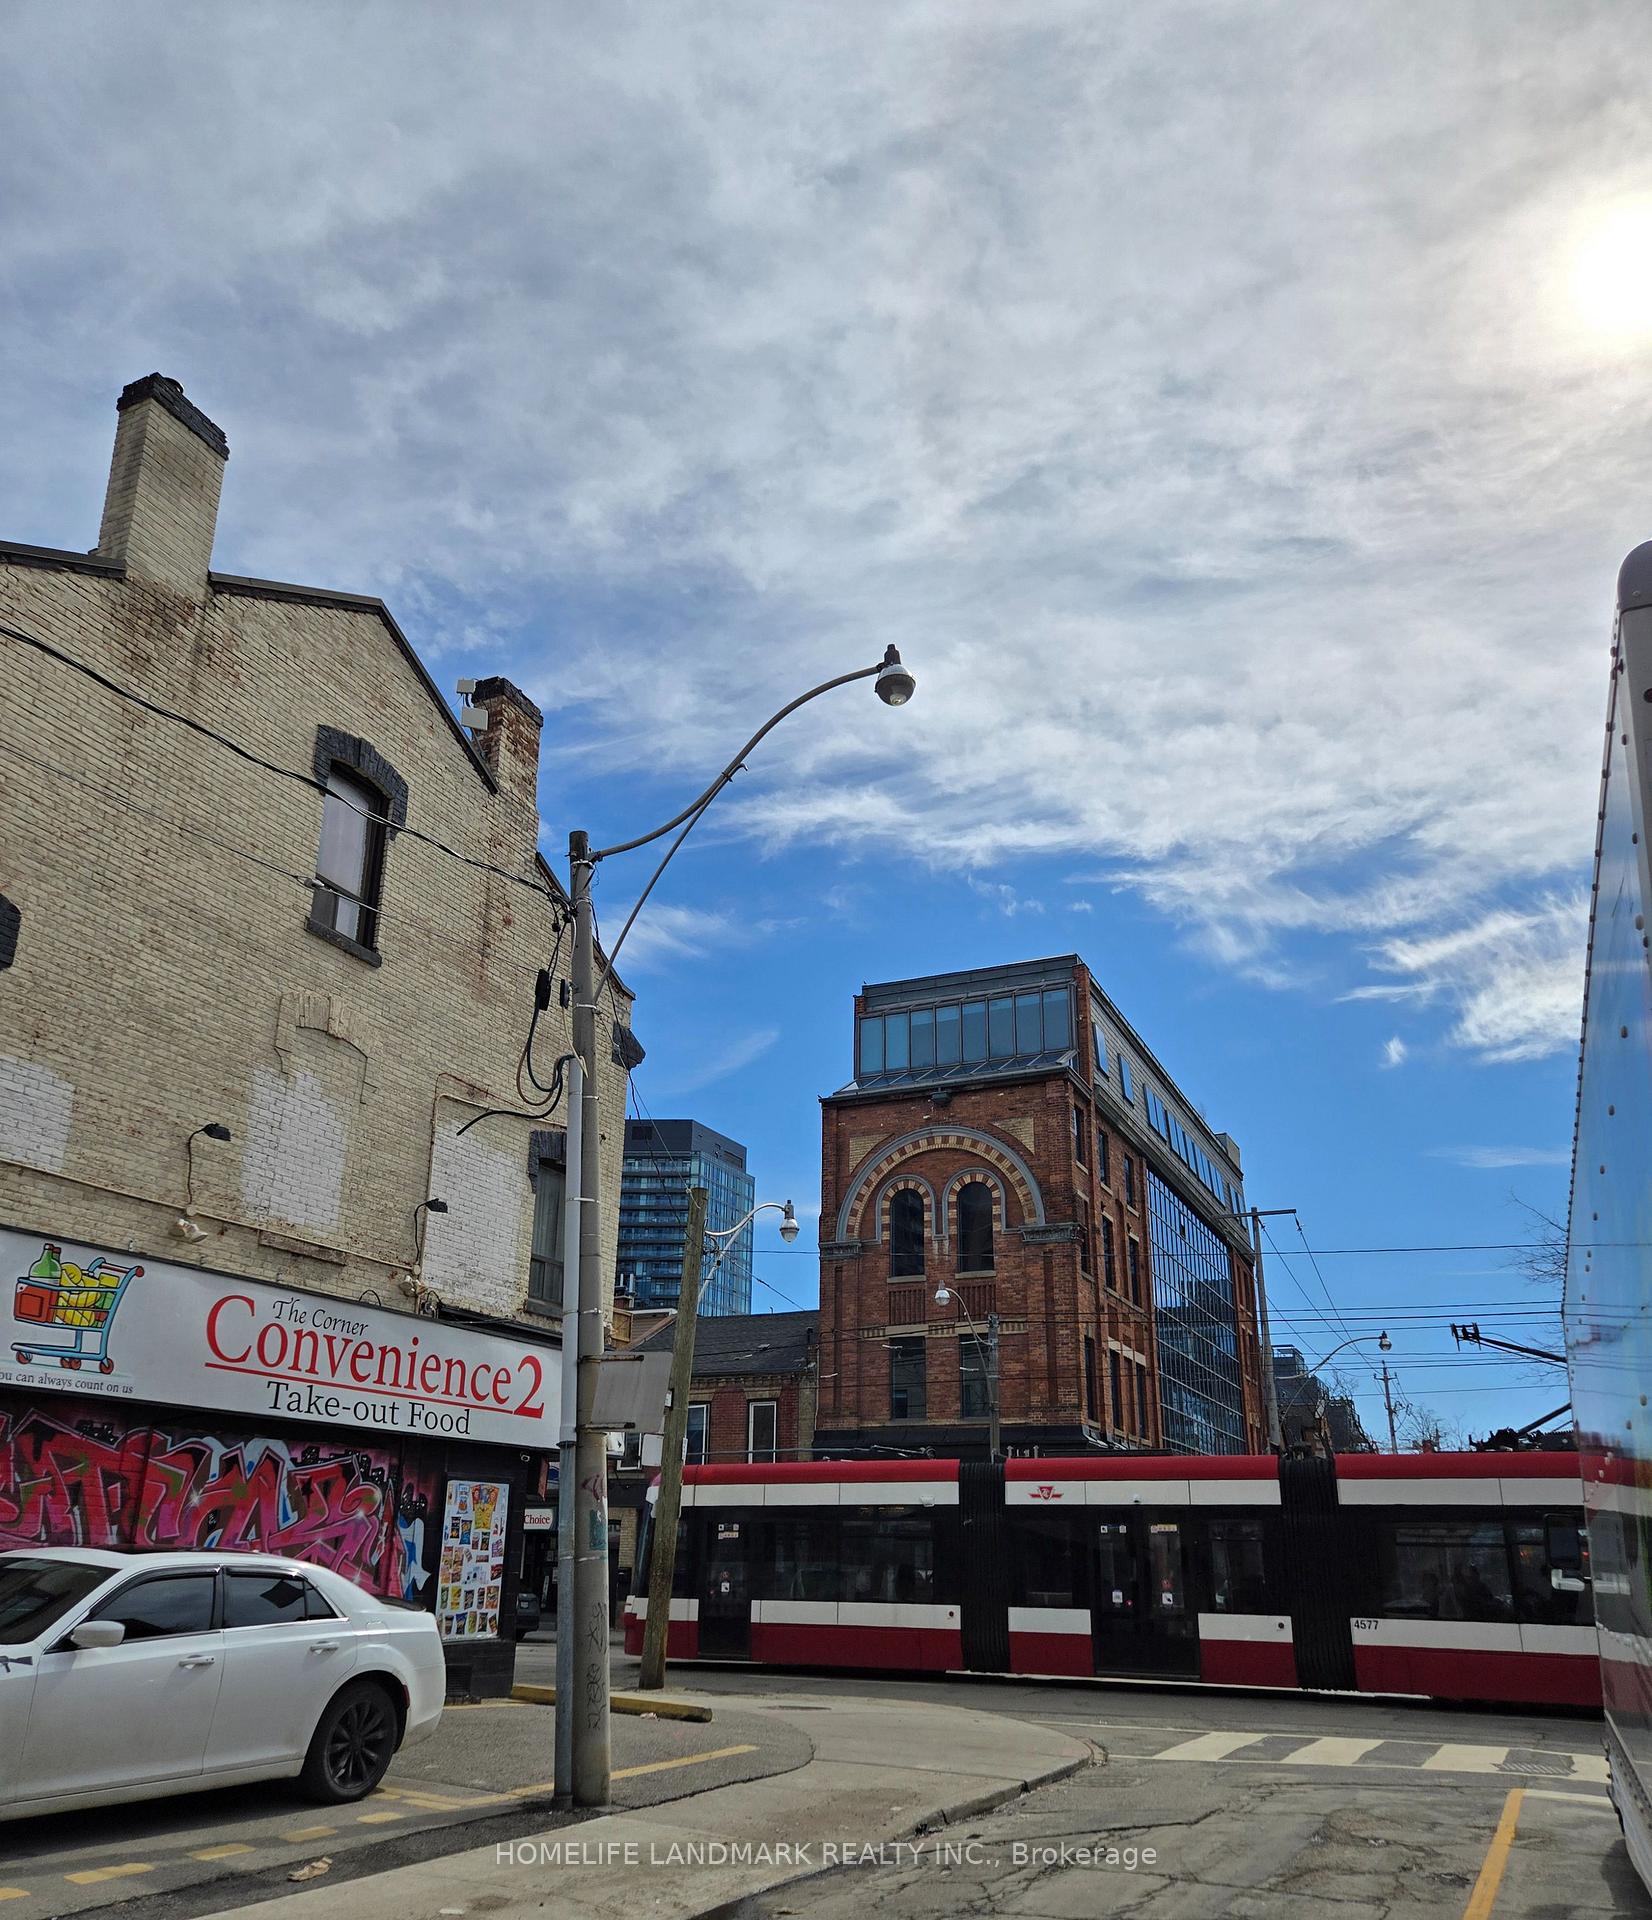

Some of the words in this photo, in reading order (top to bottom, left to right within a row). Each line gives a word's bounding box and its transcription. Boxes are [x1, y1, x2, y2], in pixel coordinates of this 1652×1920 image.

[273, 1297, 307, 1323] The
[312, 1309, 368, 1336] Corner
[16, 1374, 34, 1383] can
[38, 1373, 72, 1390] always
[75, 1380, 104, 1391] count
[106, 1384, 119, 1393] on
[122, 1384, 134, 1394] us
[267, 1381, 400, 1425] Take-out
[408, 1402, 471, 1435] Food
[524, 1514, 551, 1525] Choice
[1354, 1619, 1379, 1630] 4577
